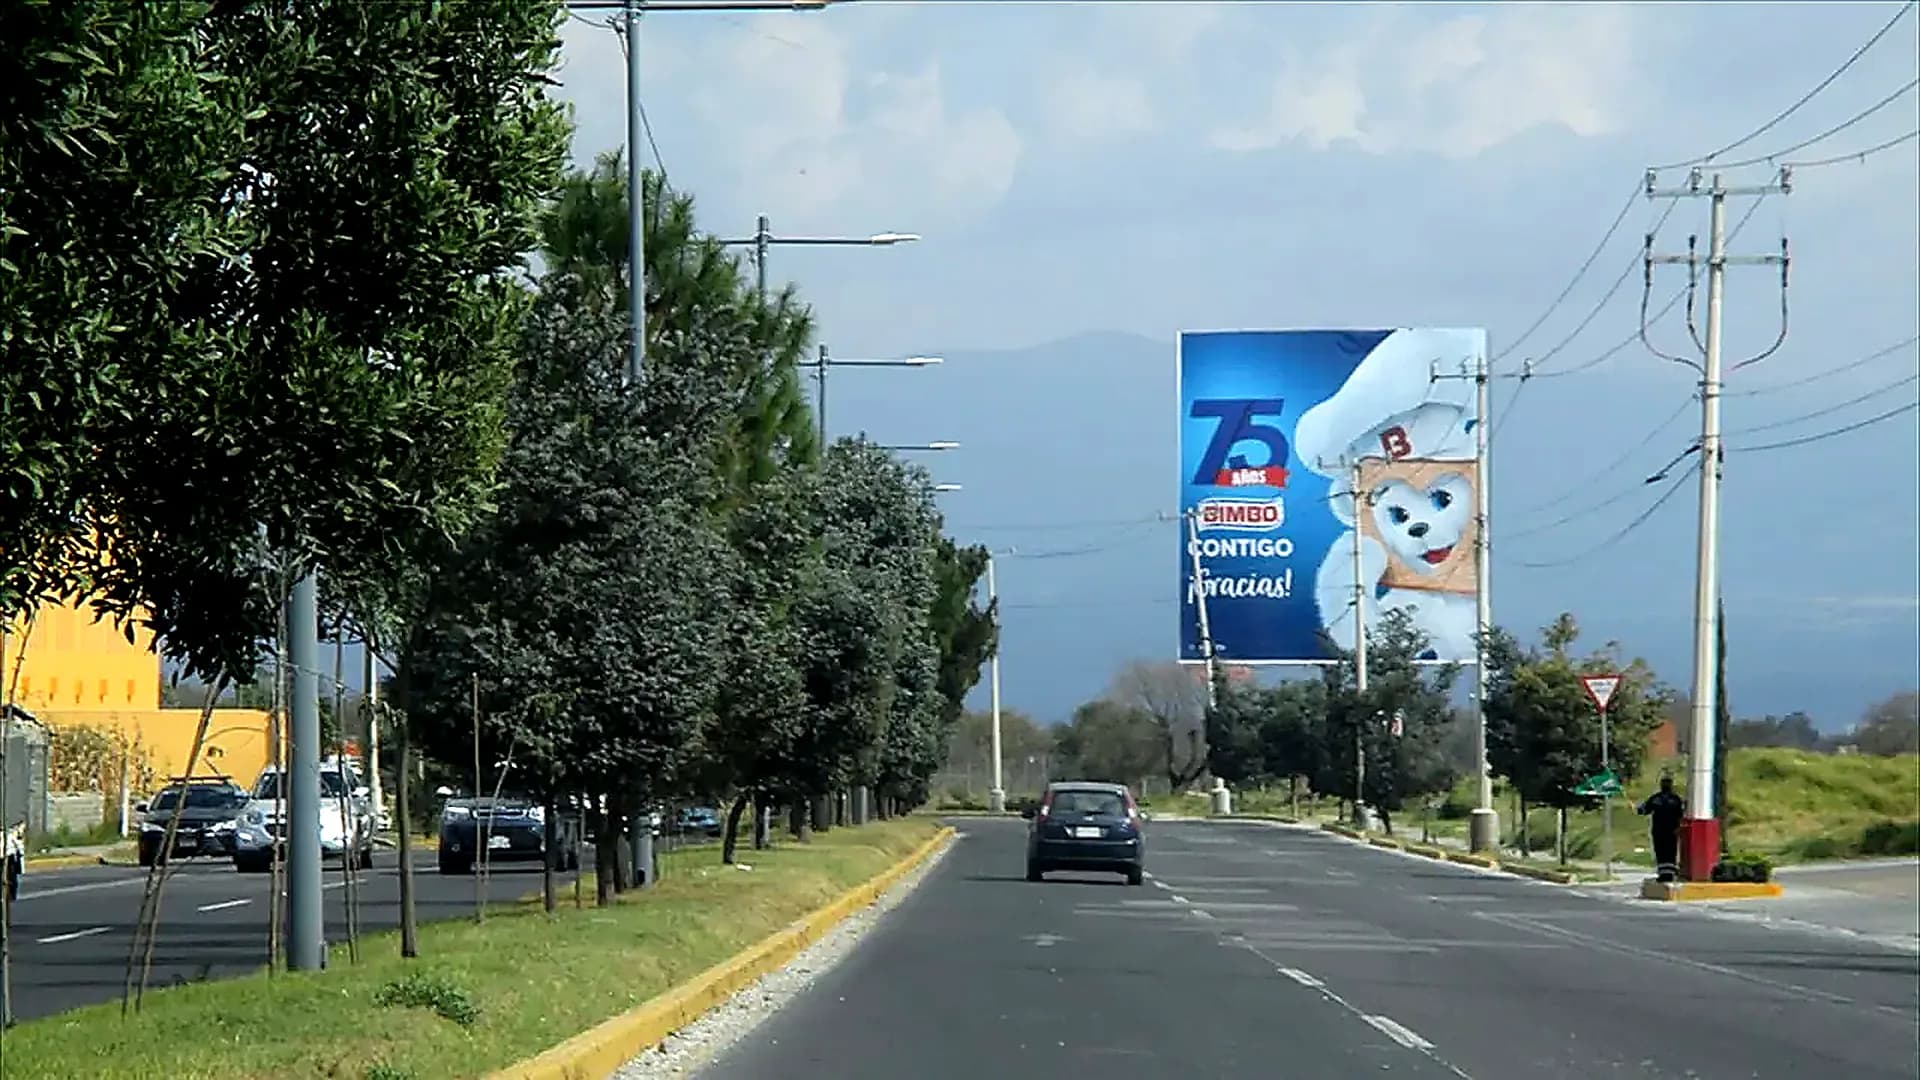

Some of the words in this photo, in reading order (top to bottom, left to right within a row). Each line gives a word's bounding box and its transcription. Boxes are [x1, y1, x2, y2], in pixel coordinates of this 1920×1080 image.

[1190, 398, 1288, 485] 75
[1381, 426, 1411, 458] B
[1203, 505, 1278, 522] BIMBO
[1187, 538, 1293, 557] CONTIGO
